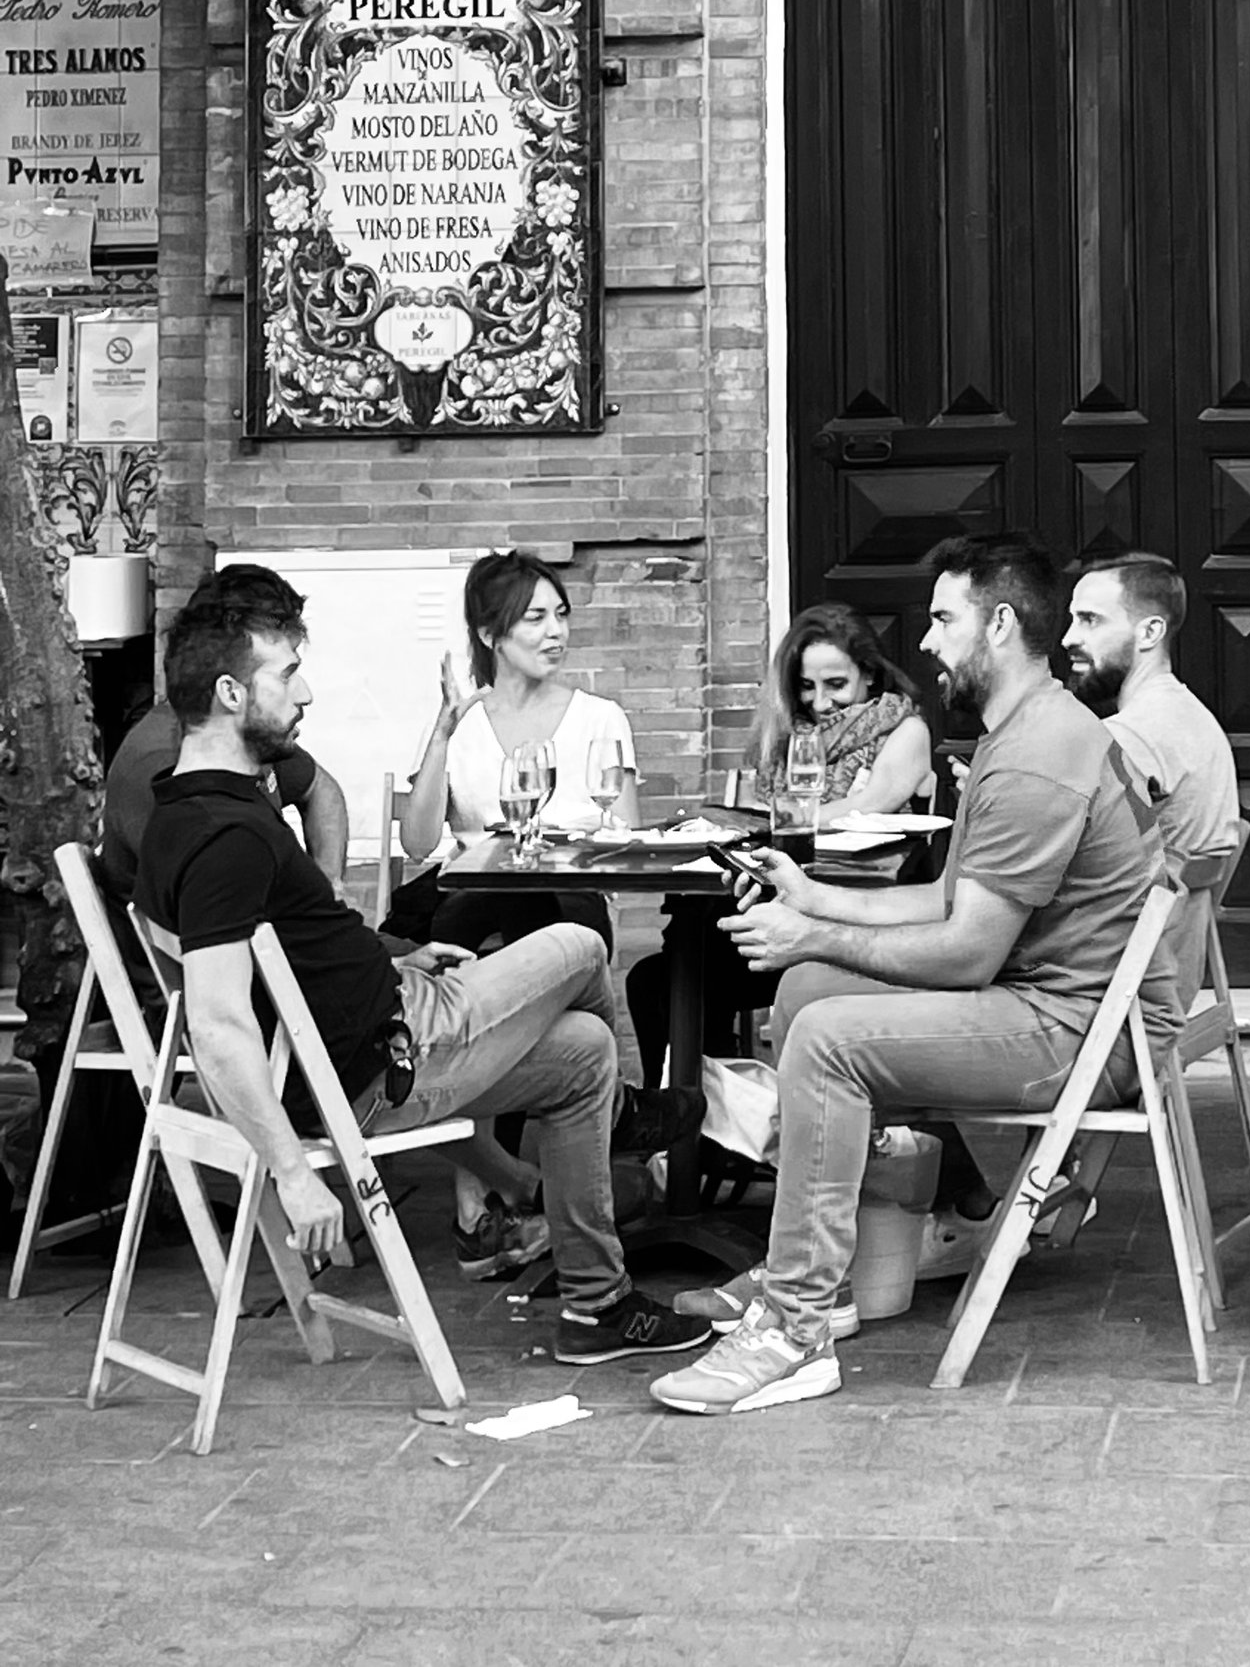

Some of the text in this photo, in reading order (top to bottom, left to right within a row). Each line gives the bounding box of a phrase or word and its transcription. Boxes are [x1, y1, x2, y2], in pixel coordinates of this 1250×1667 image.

[5, 47, 146, 75] TRES ALAMOS
[398, 48, 453, 70] VINOS
[26, 87, 127, 108] PEDRO XIMENEZ
[363, 81, 485, 105] MANZANILLA
[351, 109, 498, 139] MOSTO DEL AÑO
[11, 133, 141, 150] BRANDY DE JEREZ
[331, 148, 518, 172] VERMUT DE BODEGA
[342, 182, 506, 207] VINO DE NARANJA
[356, 216, 493, 240] VINO DE FRESA
[379, 250, 471, 273] ANISADOS
